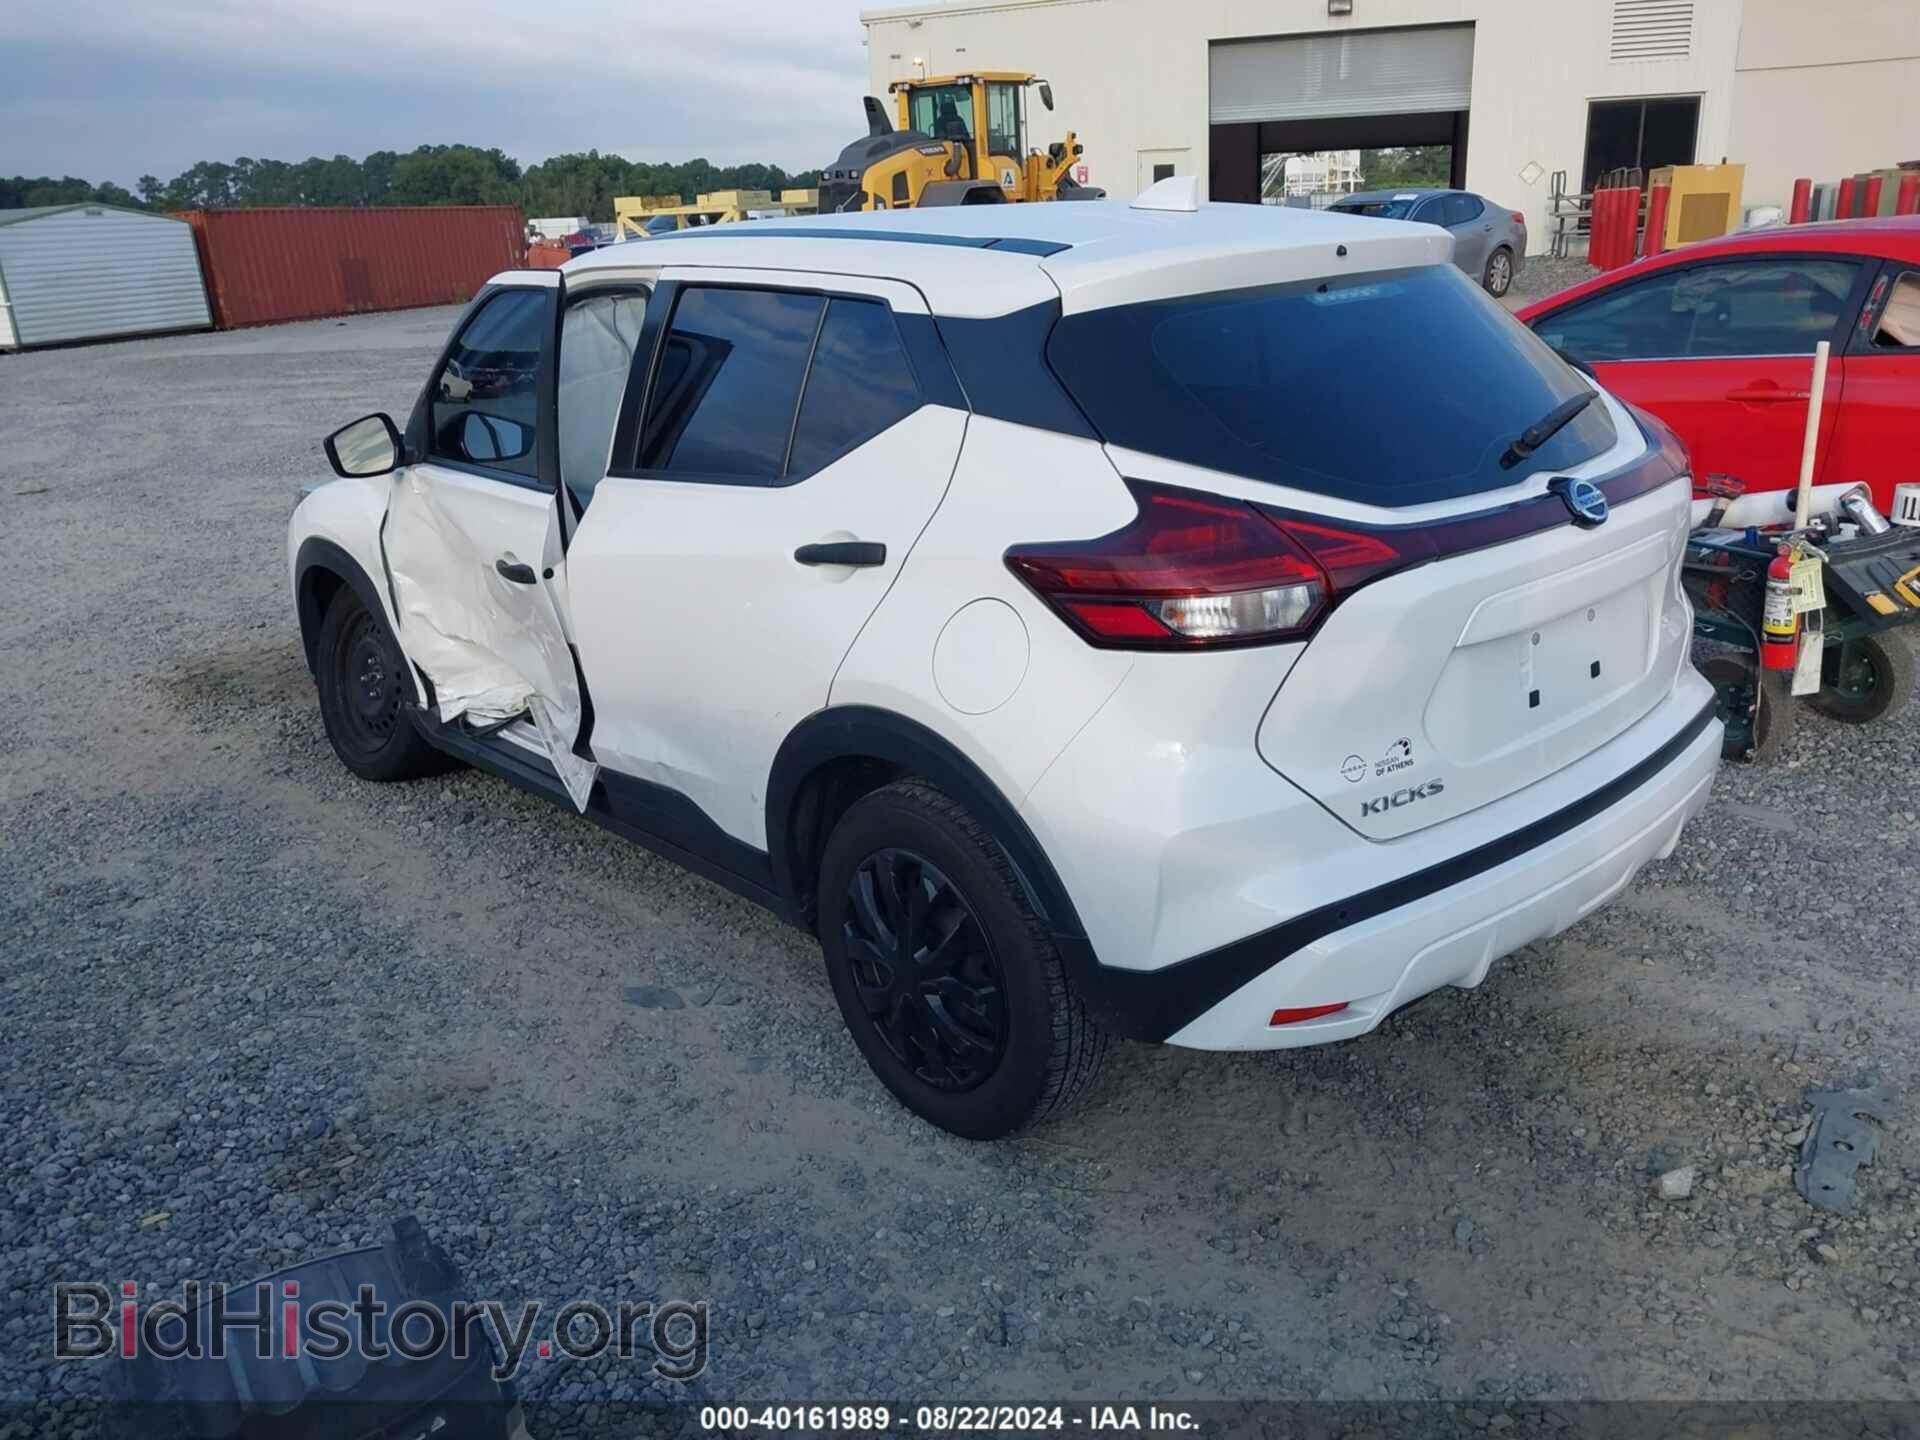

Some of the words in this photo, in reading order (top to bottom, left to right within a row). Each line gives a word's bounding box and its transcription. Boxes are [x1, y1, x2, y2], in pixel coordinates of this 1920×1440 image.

[1375, 756, 1400, 768] NISSAN
[1375, 767, 1386, 777] OF
[1387, 758, 1415, 774] ATHENS
[1361, 777, 1445, 818] KICKS
